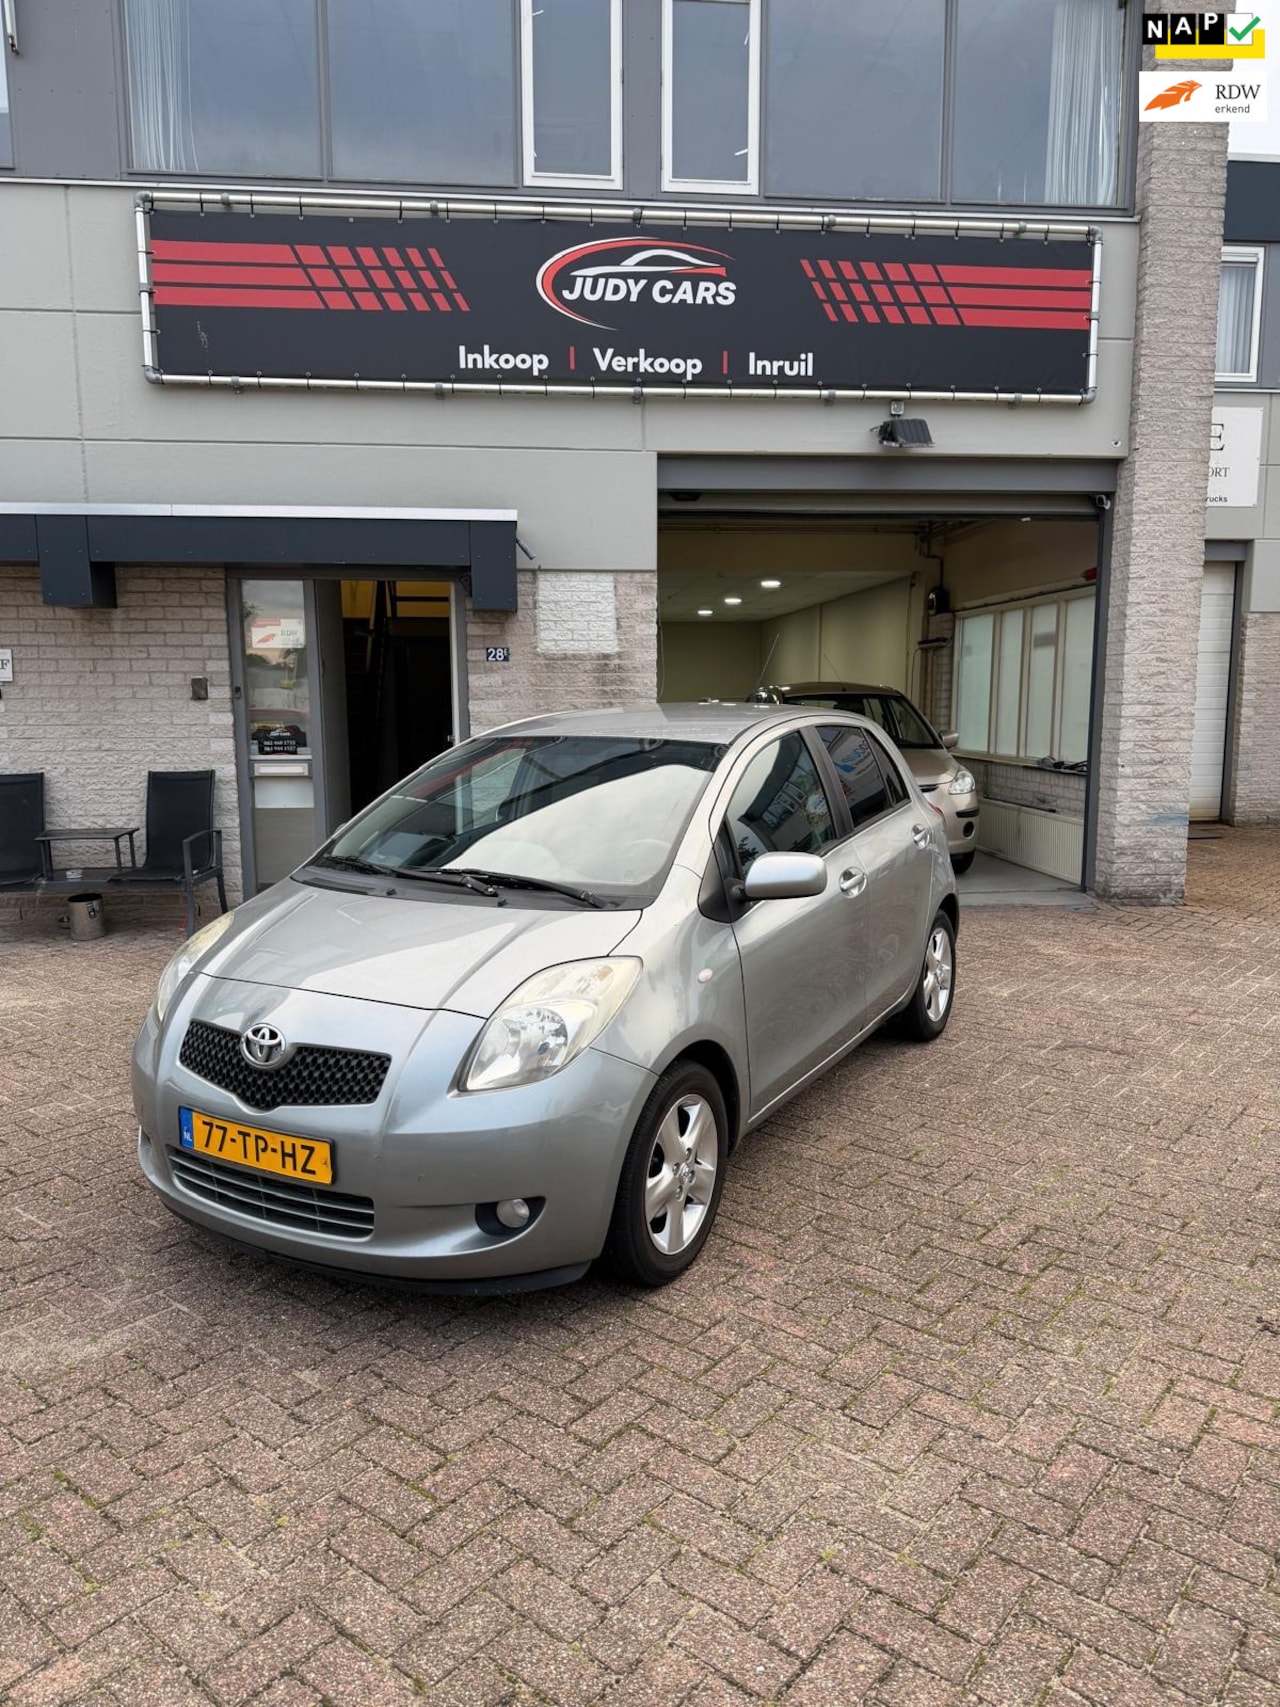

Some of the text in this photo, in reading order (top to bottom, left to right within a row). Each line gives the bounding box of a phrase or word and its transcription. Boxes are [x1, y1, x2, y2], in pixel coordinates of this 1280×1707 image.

[561, 276, 737, 306] JUDY CARS
[458, 344, 814, 381] Inkoop Verkoop Inruil
[183, 1131, 193, 1142] NL
[202, 1120, 317, 1176] 77-TP-HZ
